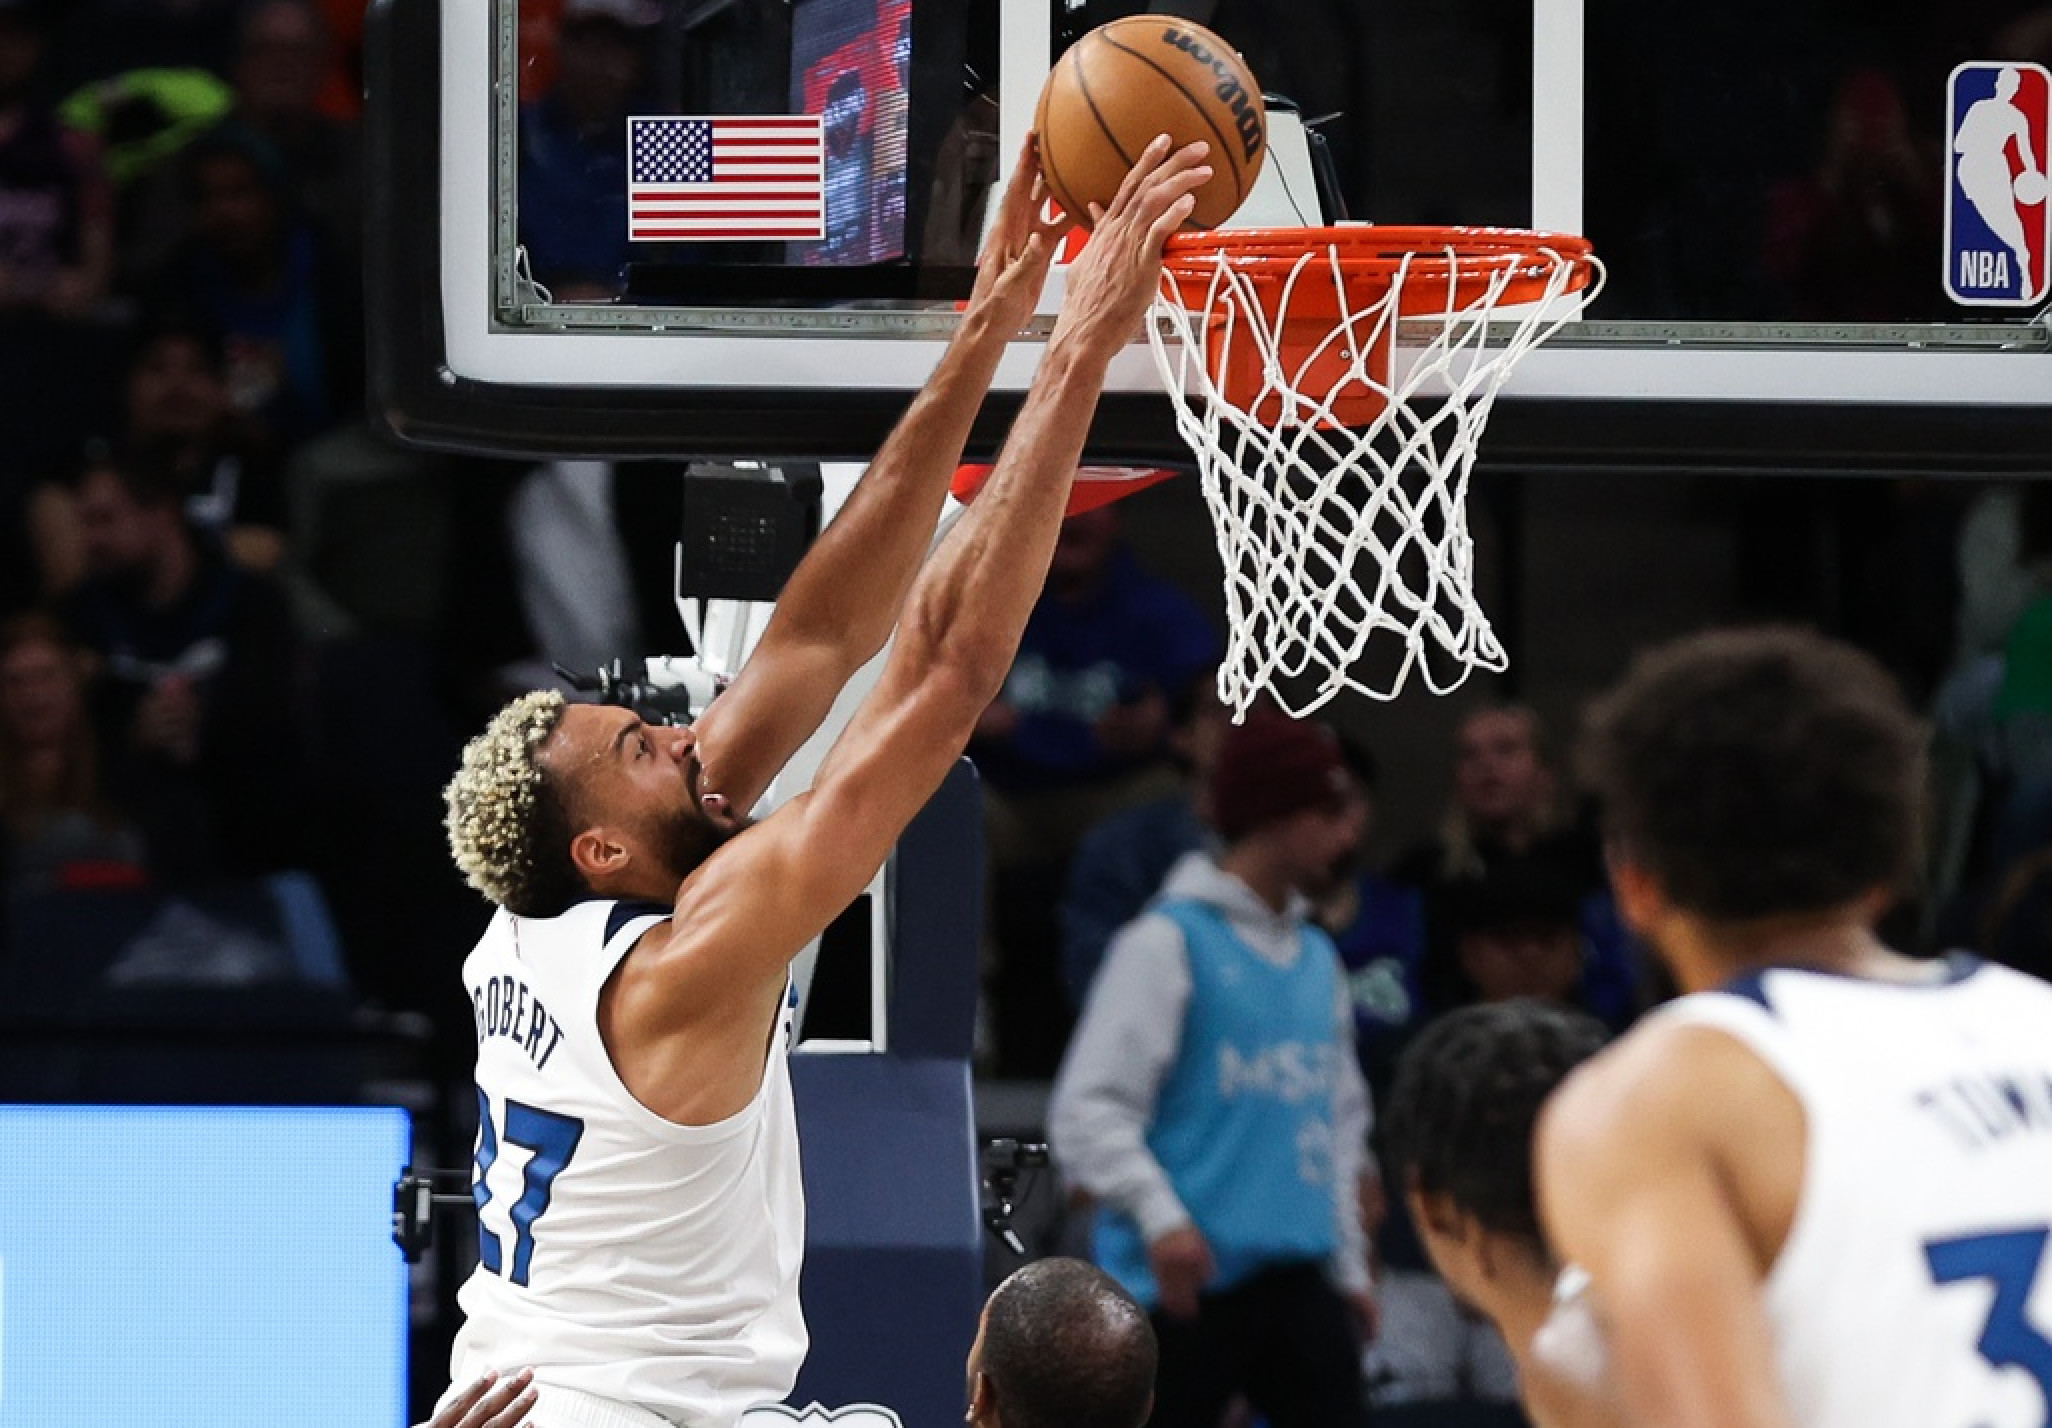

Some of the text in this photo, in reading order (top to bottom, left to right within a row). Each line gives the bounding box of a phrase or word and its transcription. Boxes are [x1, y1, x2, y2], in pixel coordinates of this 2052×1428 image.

[1162, 28, 1262, 164] Wilson
[1960, 250, 2010, 289] NBA
[473, 974, 565, 1071] GOBERT
